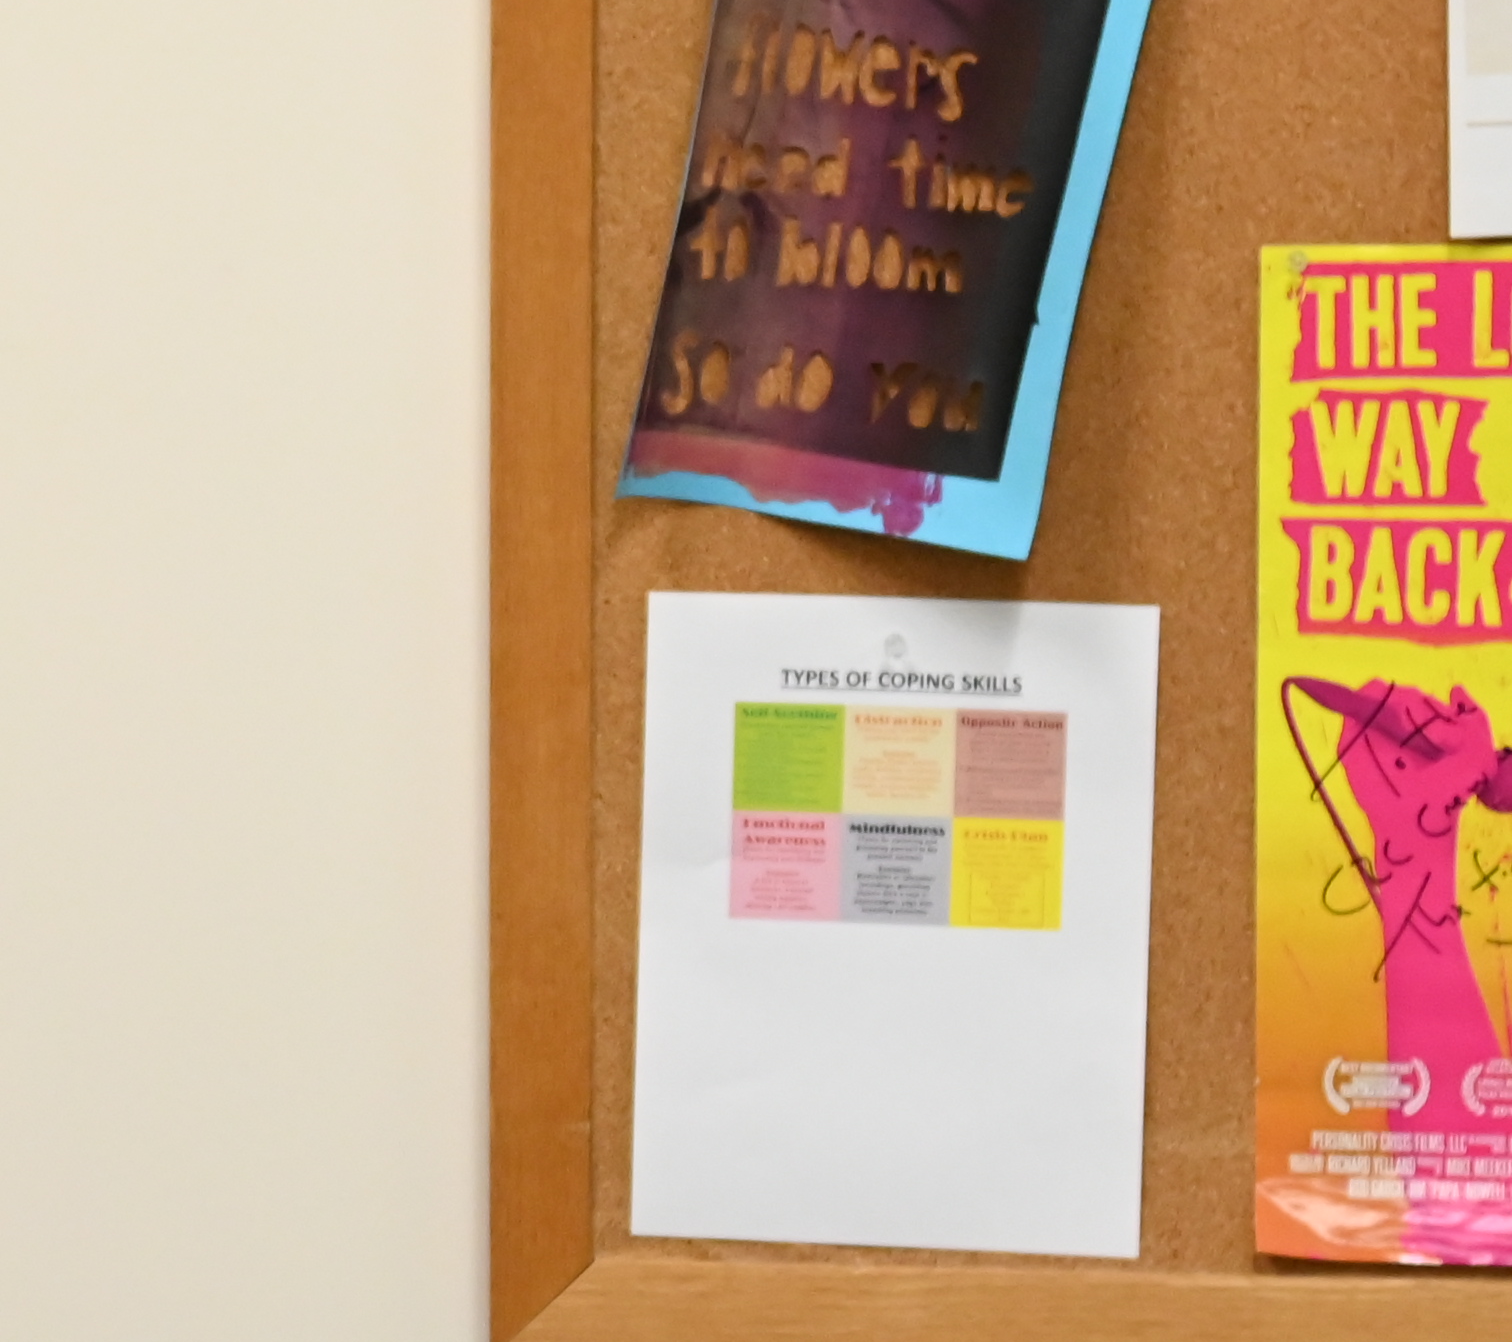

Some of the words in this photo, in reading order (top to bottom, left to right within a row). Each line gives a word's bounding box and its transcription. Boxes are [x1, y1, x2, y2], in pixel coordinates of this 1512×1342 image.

[690, 206, 751, 282] to
[777, 212, 964, 293] bloom
[1303, 270, 1439, 369] THE
[1308, 397, 1462, 499] WAY
[1305, 526, 1506, 629] BACK
[781, 668, 840, 688] TYPES
[846, 671, 870, 688] OF
[878, 672, 955, 692] COPING
[961, 675, 1023, 694] SKILLS
[849, 822, 946, 838] Mindfulness
